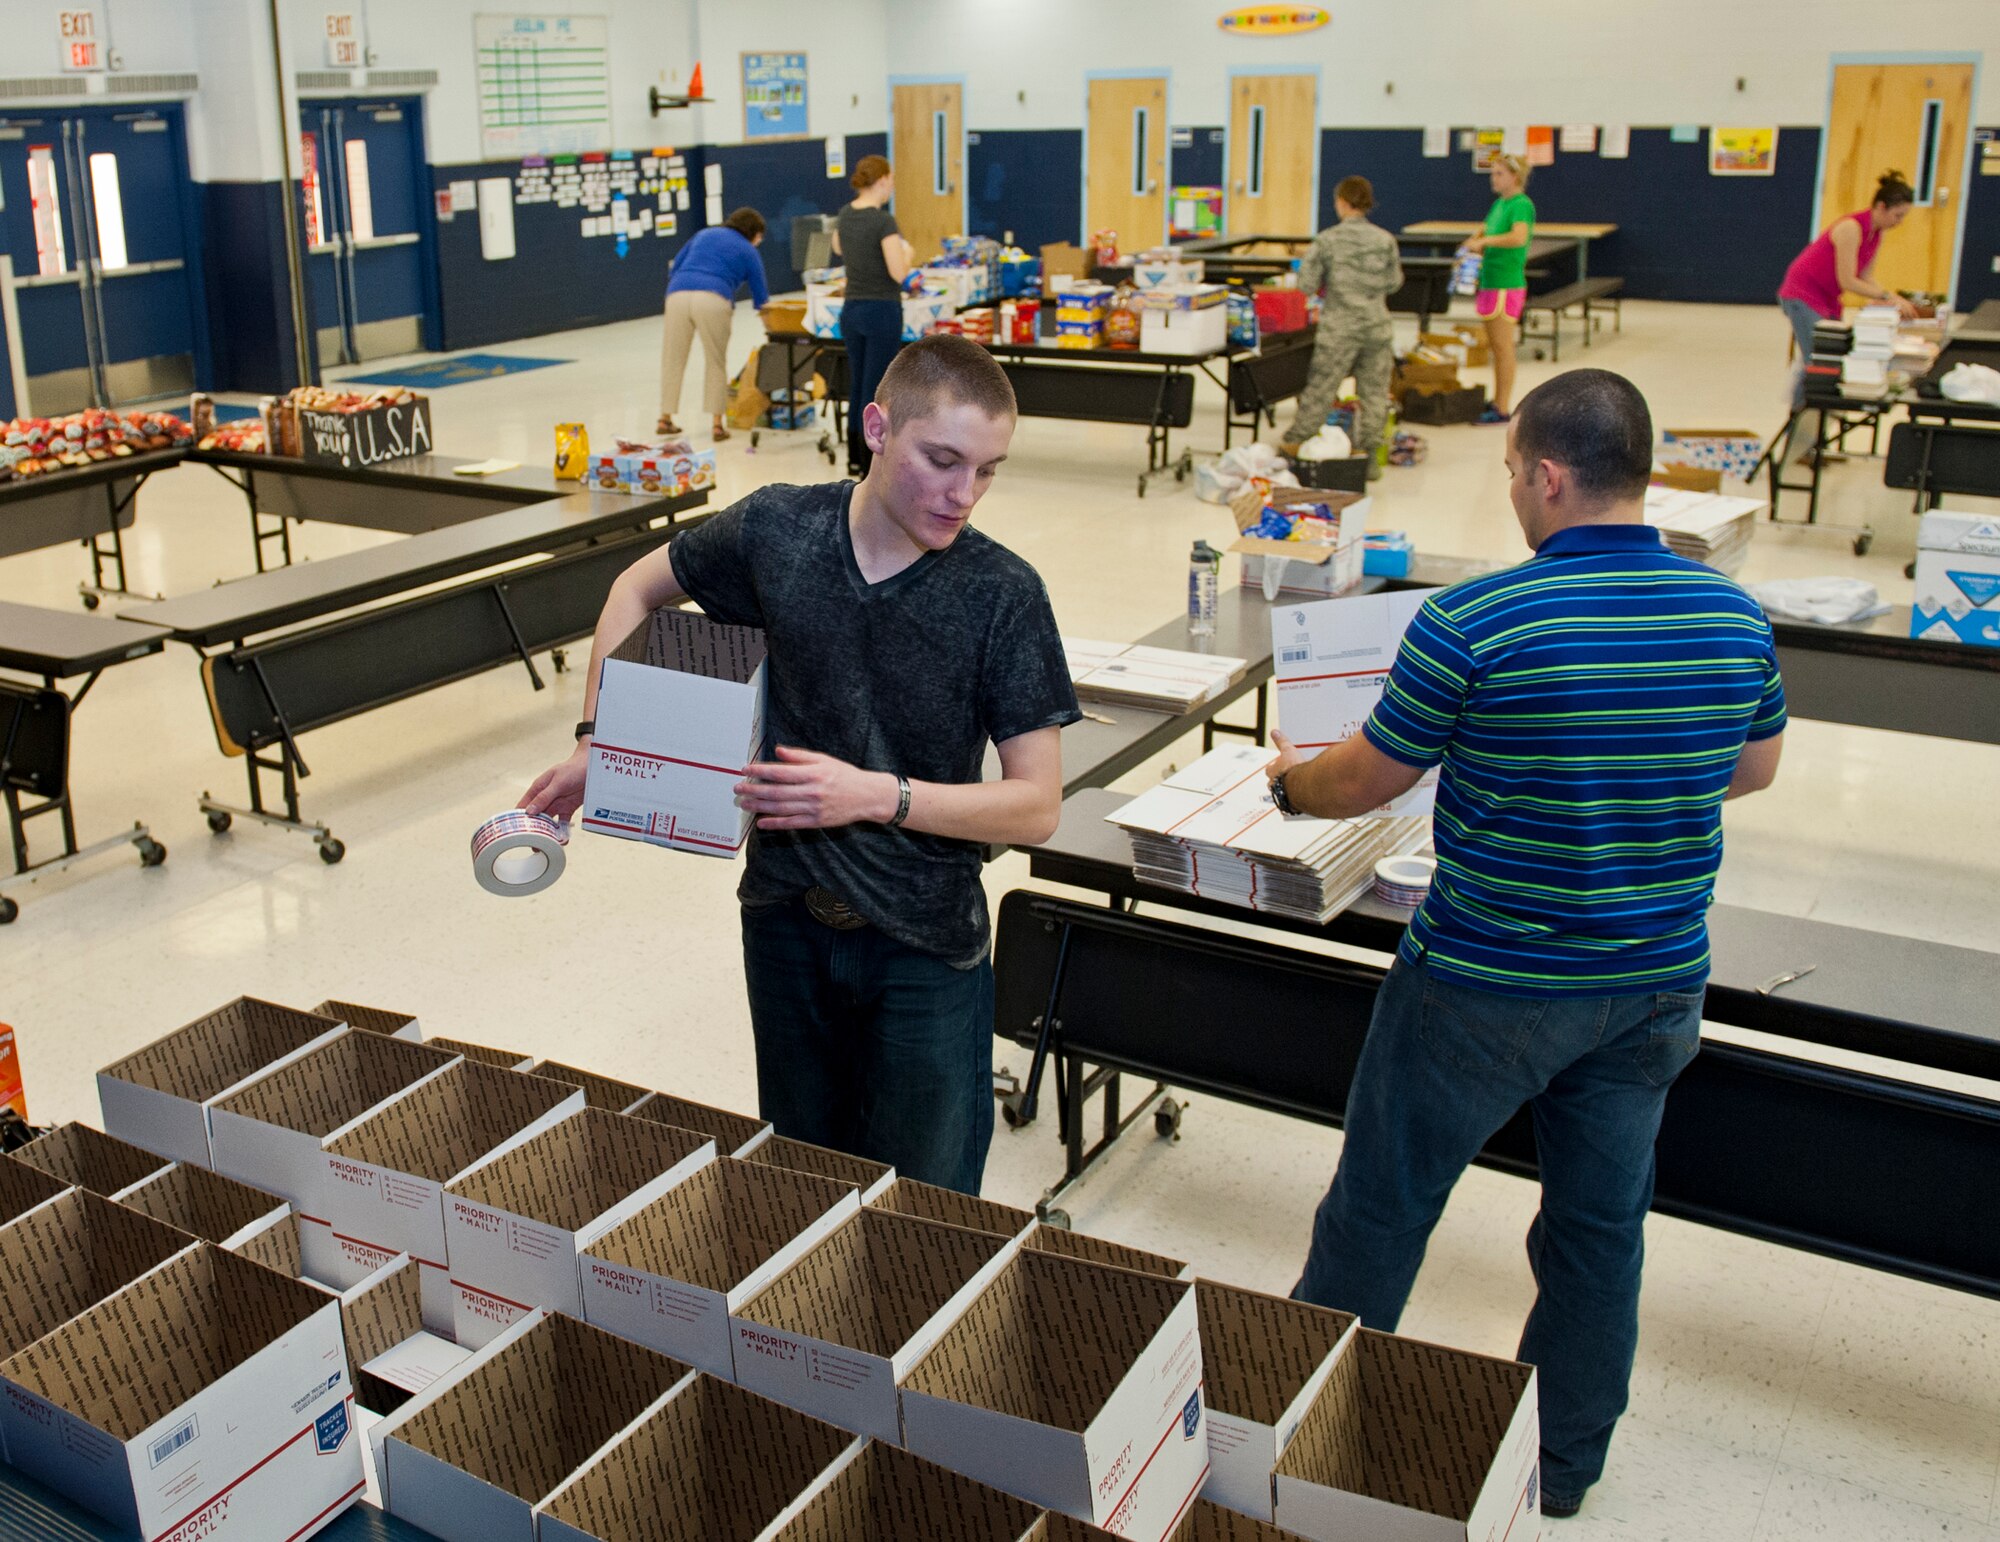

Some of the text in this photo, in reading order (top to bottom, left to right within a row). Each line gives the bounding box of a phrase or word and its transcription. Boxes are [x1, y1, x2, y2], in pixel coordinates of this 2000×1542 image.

[60, 12, 95, 37] EXIT
[326, 15, 352, 37] EXIT
[71, 42, 97, 67] EXIT
[601, 752, 664, 772] PRIORITY
[614, 765, 647, 779] MAIL
[677, 827, 690, 835] VISIT
[329, 1160, 374, 1179] PRIORITY
[342, 1173, 365, 1186] MAIL
[455, 1203, 501, 1225] PRIORITY
[467, 1217, 491, 1232] MAIL
[342, 1241, 390, 1263] PRIORITY
[355, 1256, 379, 1270] MAIL
[592, 1265, 644, 1288] PRIORITY
[605, 1280, 632, 1294] MAIL
[462, 1291, 513, 1317] PRIORITY
[475, 1307, 502, 1323] MAIL
[741, 1328, 797, 1353] PRIORITY
[756, 1344, 785, 1360] MAIL
[6, 1385, 52, 1418] PRIORITY
[19, 1404, 44, 1424] MAIL
[319, 1410, 343, 1430] TRACKED
[1098, 1440, 1133, 1495] PRIORITY
[1107, 1468, 1126, 1495] MAIL
[188, 1523, 217, 1542] AIL
[1115, 1512, 1133, 1536] AIL
